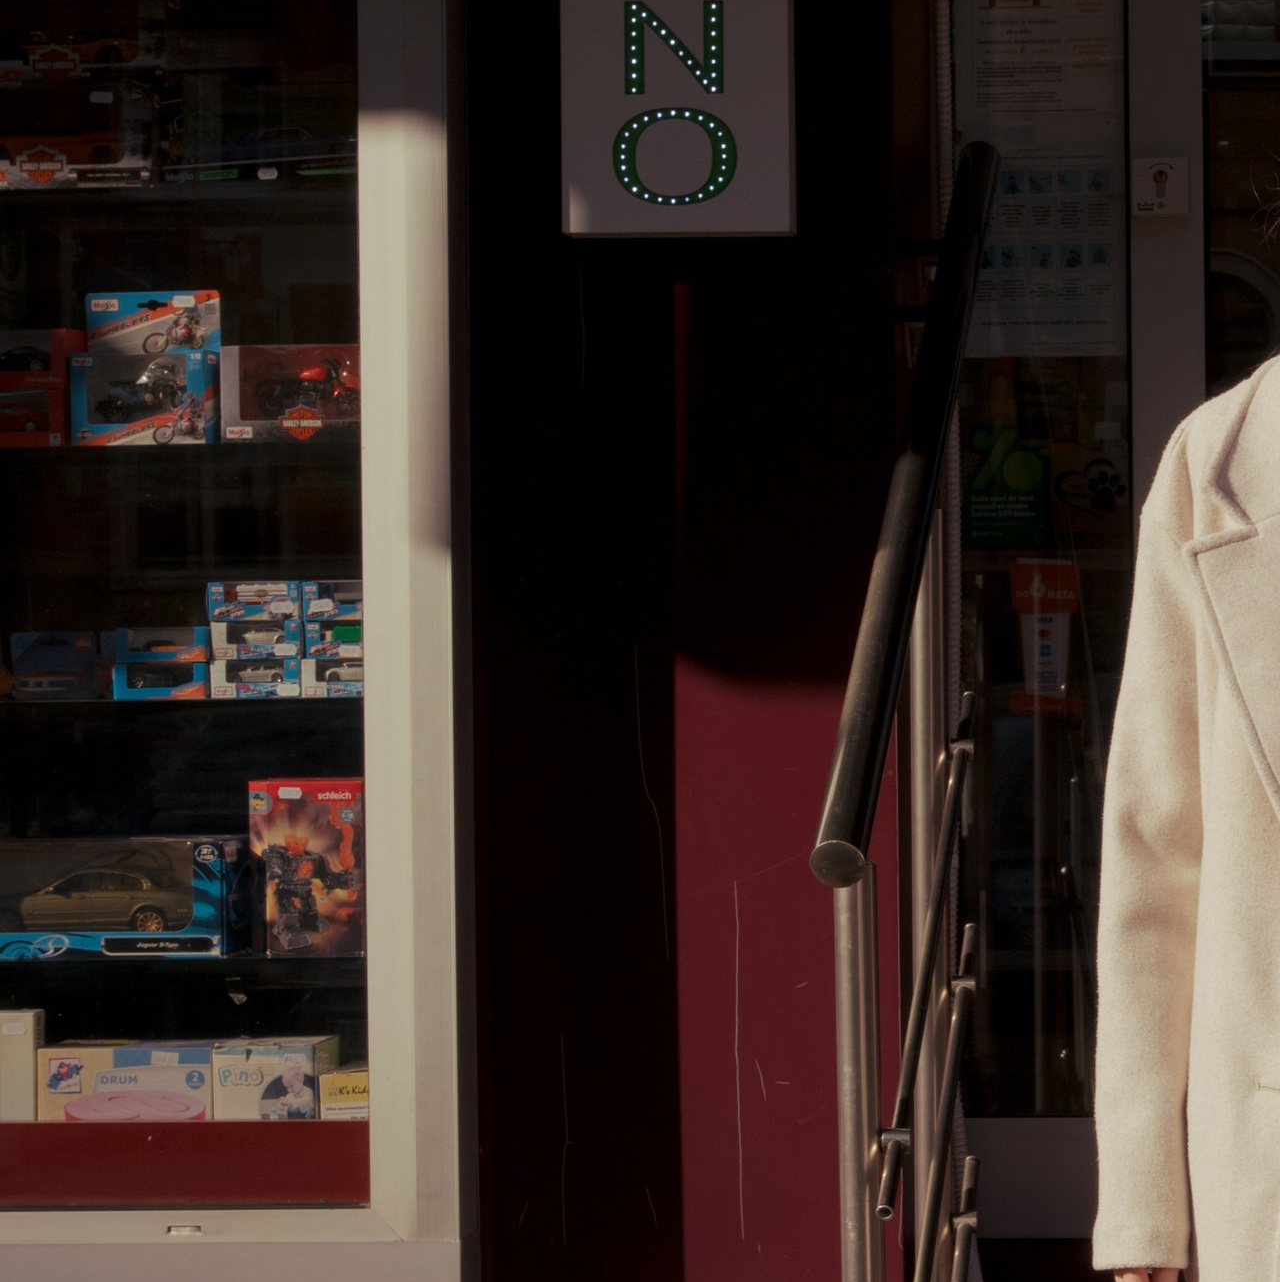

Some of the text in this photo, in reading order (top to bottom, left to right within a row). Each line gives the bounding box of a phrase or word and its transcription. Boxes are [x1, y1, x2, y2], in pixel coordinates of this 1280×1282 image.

[317, 790, 352, 800] schleich
[99, 1075, 139, 1085] DRUM
[220, 1067, 262, 1085] Pino
